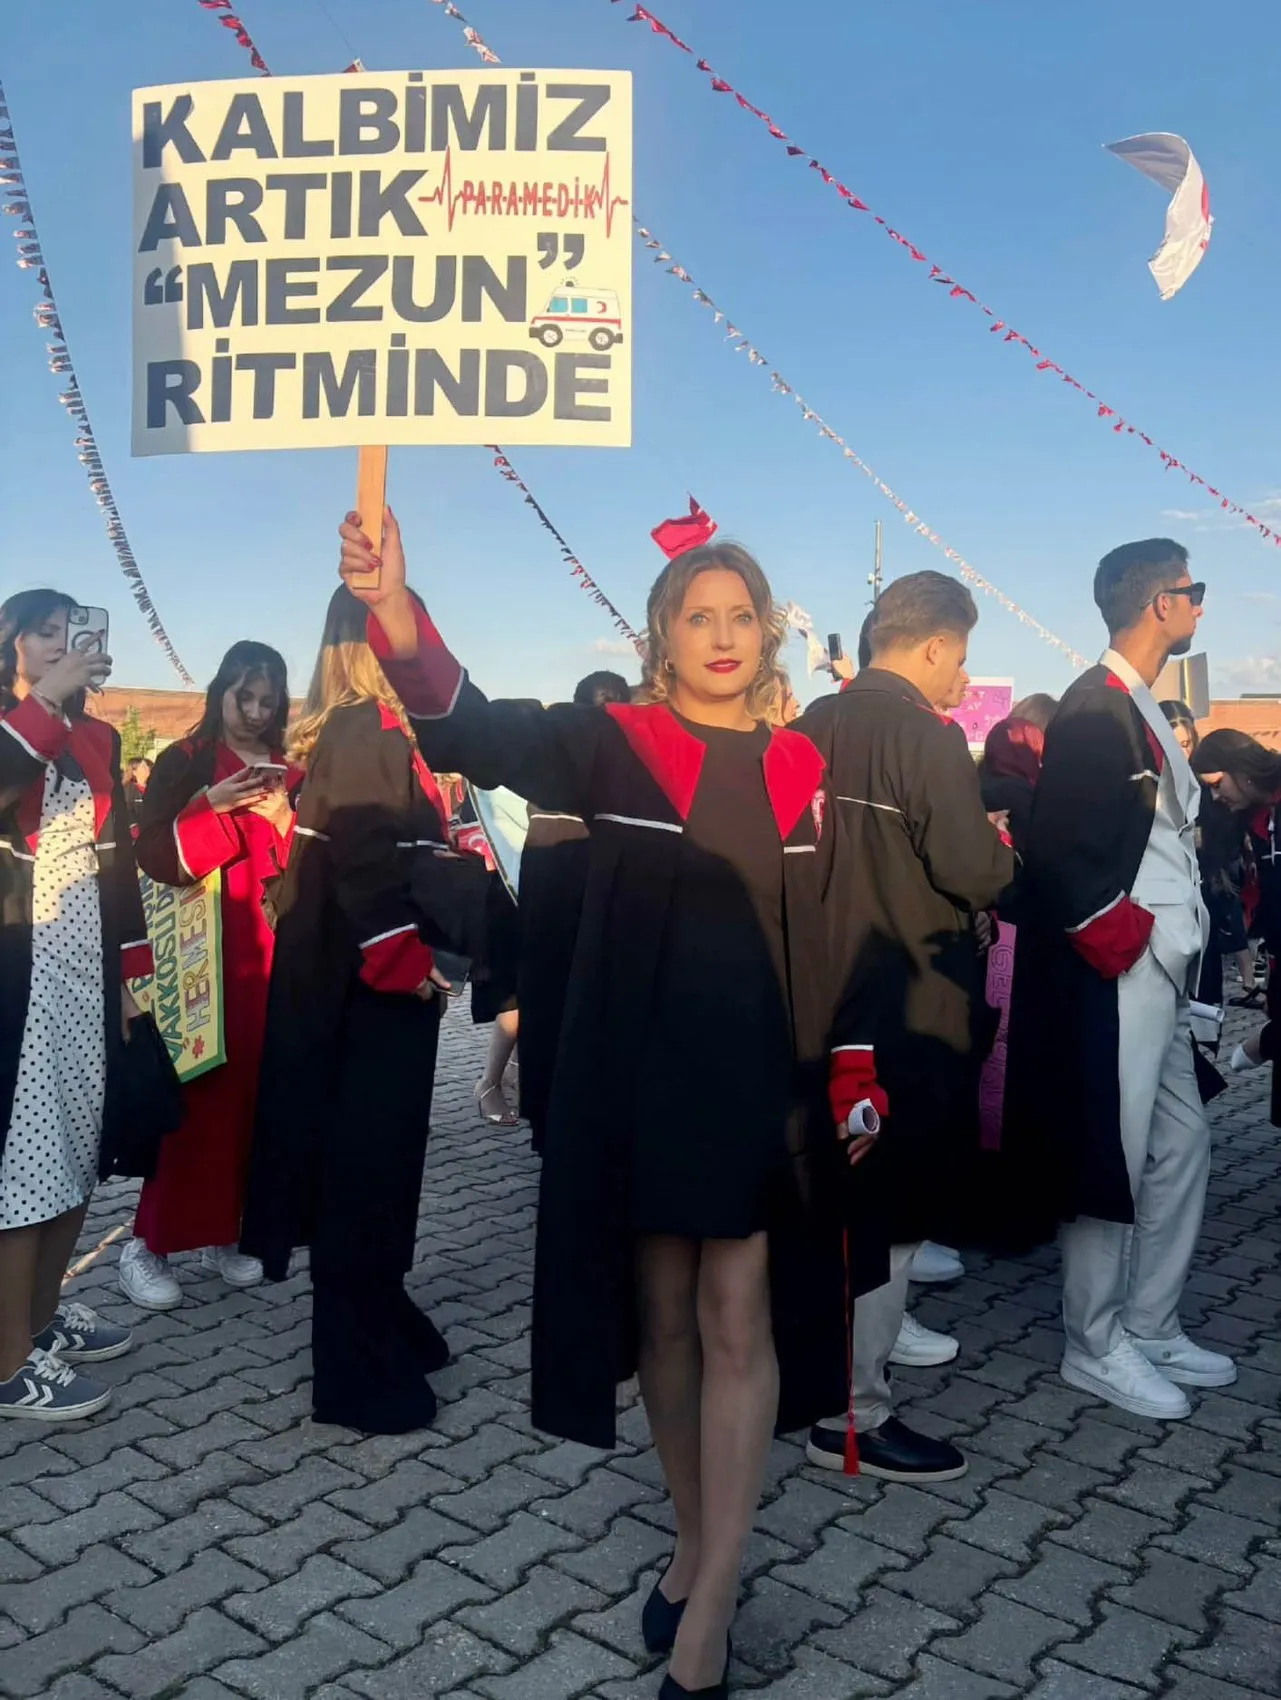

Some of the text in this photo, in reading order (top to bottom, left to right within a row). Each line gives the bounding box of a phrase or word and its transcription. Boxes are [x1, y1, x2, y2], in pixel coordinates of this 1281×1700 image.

[142, 72, 612, 169] KALBİMİZ
[138, 169, 598, 253] ARTIK PARAMEDİK
[146, 333, 612, 428] RİTMİNDE
